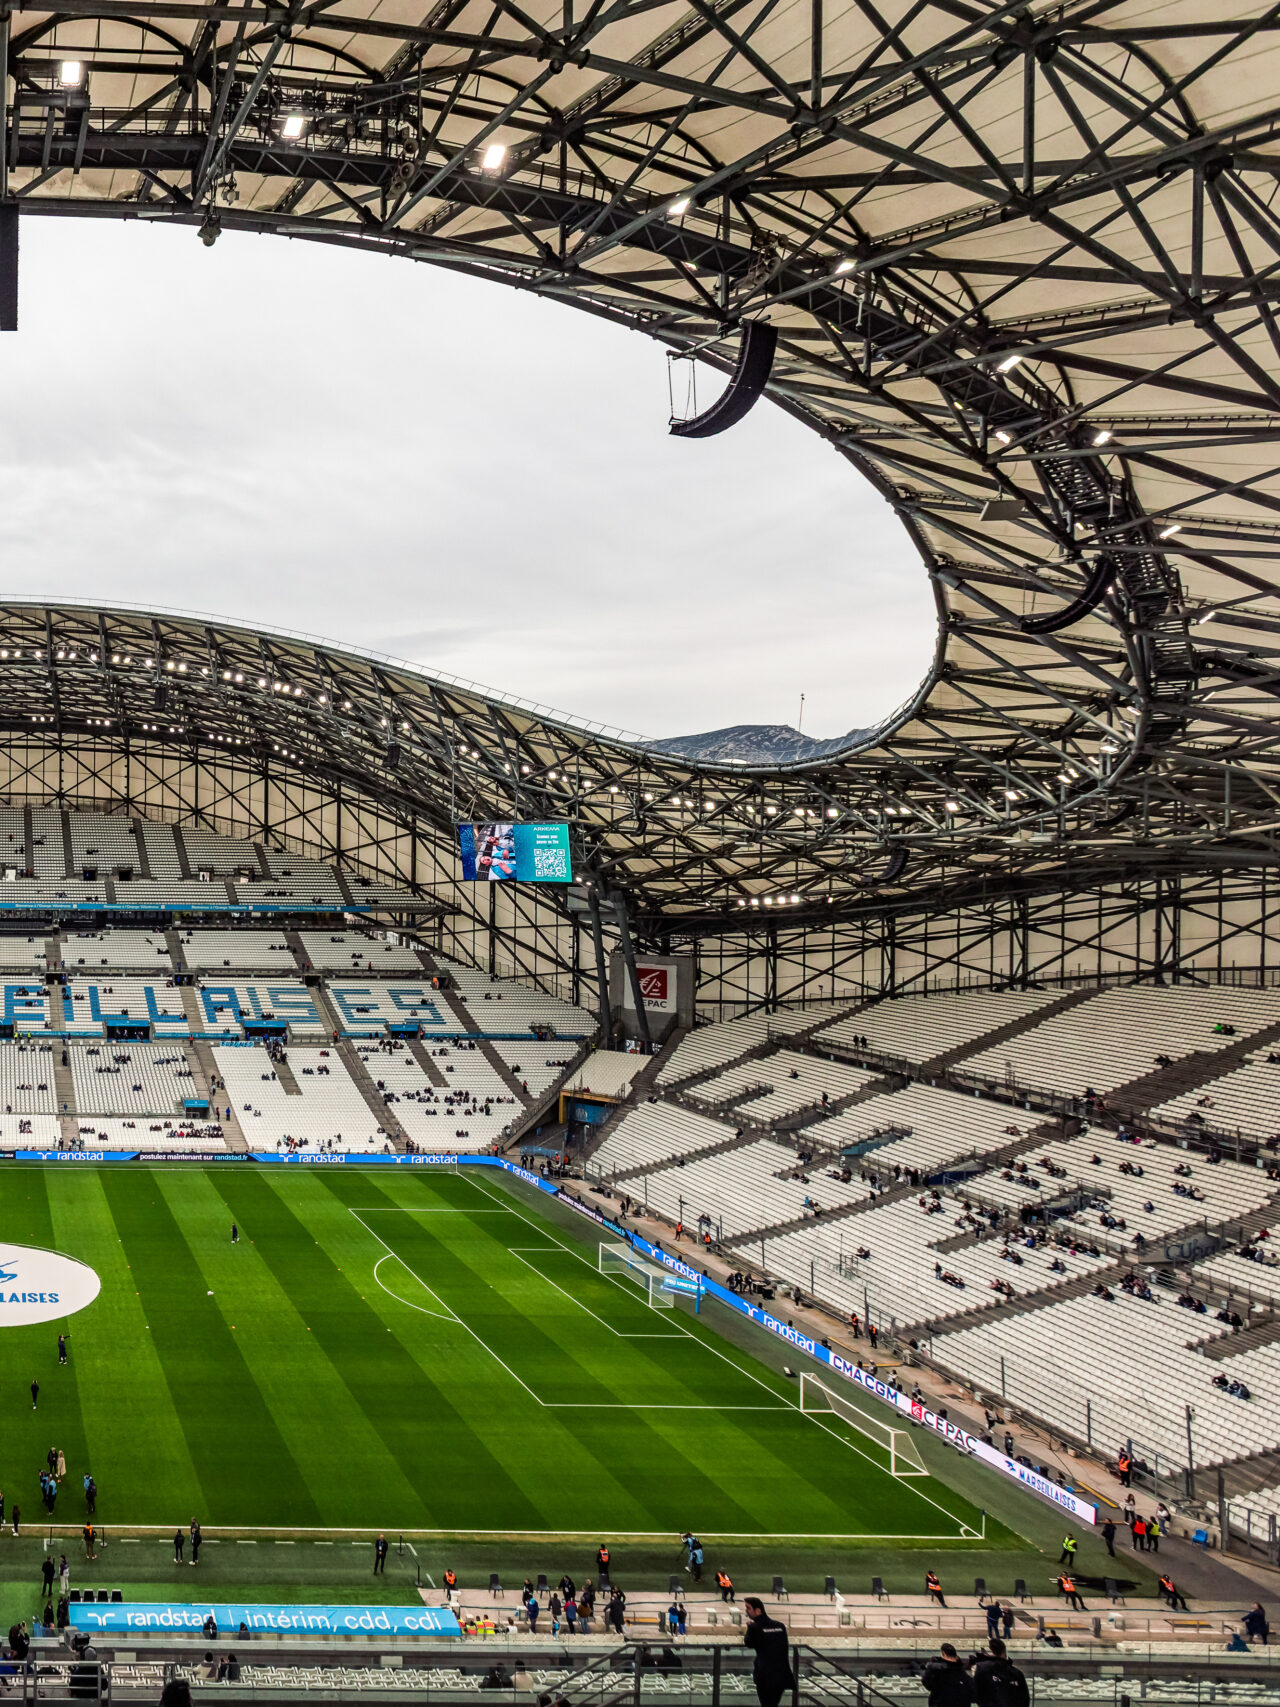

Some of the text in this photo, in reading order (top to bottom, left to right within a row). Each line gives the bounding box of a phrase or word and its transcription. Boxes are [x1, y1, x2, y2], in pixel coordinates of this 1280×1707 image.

[642, 1000, 668, 1009] EPAC
[57, 1151, 104, 1161] randstad
[139, 1153, 166, 1161] postulez
[214, 1153, 248, 1161] randstad.fr
[298, 1153, 345, 1163] randstad
[411, 1155, 458, 1164] randstad
[512, 1165, 539, 1186] randstad
[663, 1253, 702, 1285] randstad
[763, 1313, 815, 1354] randstad
[923, 1406, 978, 1453] CEPAC
[1019, 1468, 1077, 1512] MARSEILLAISES
[126, 1608, 442, 1633] randstad intérim, cdd, cdi
